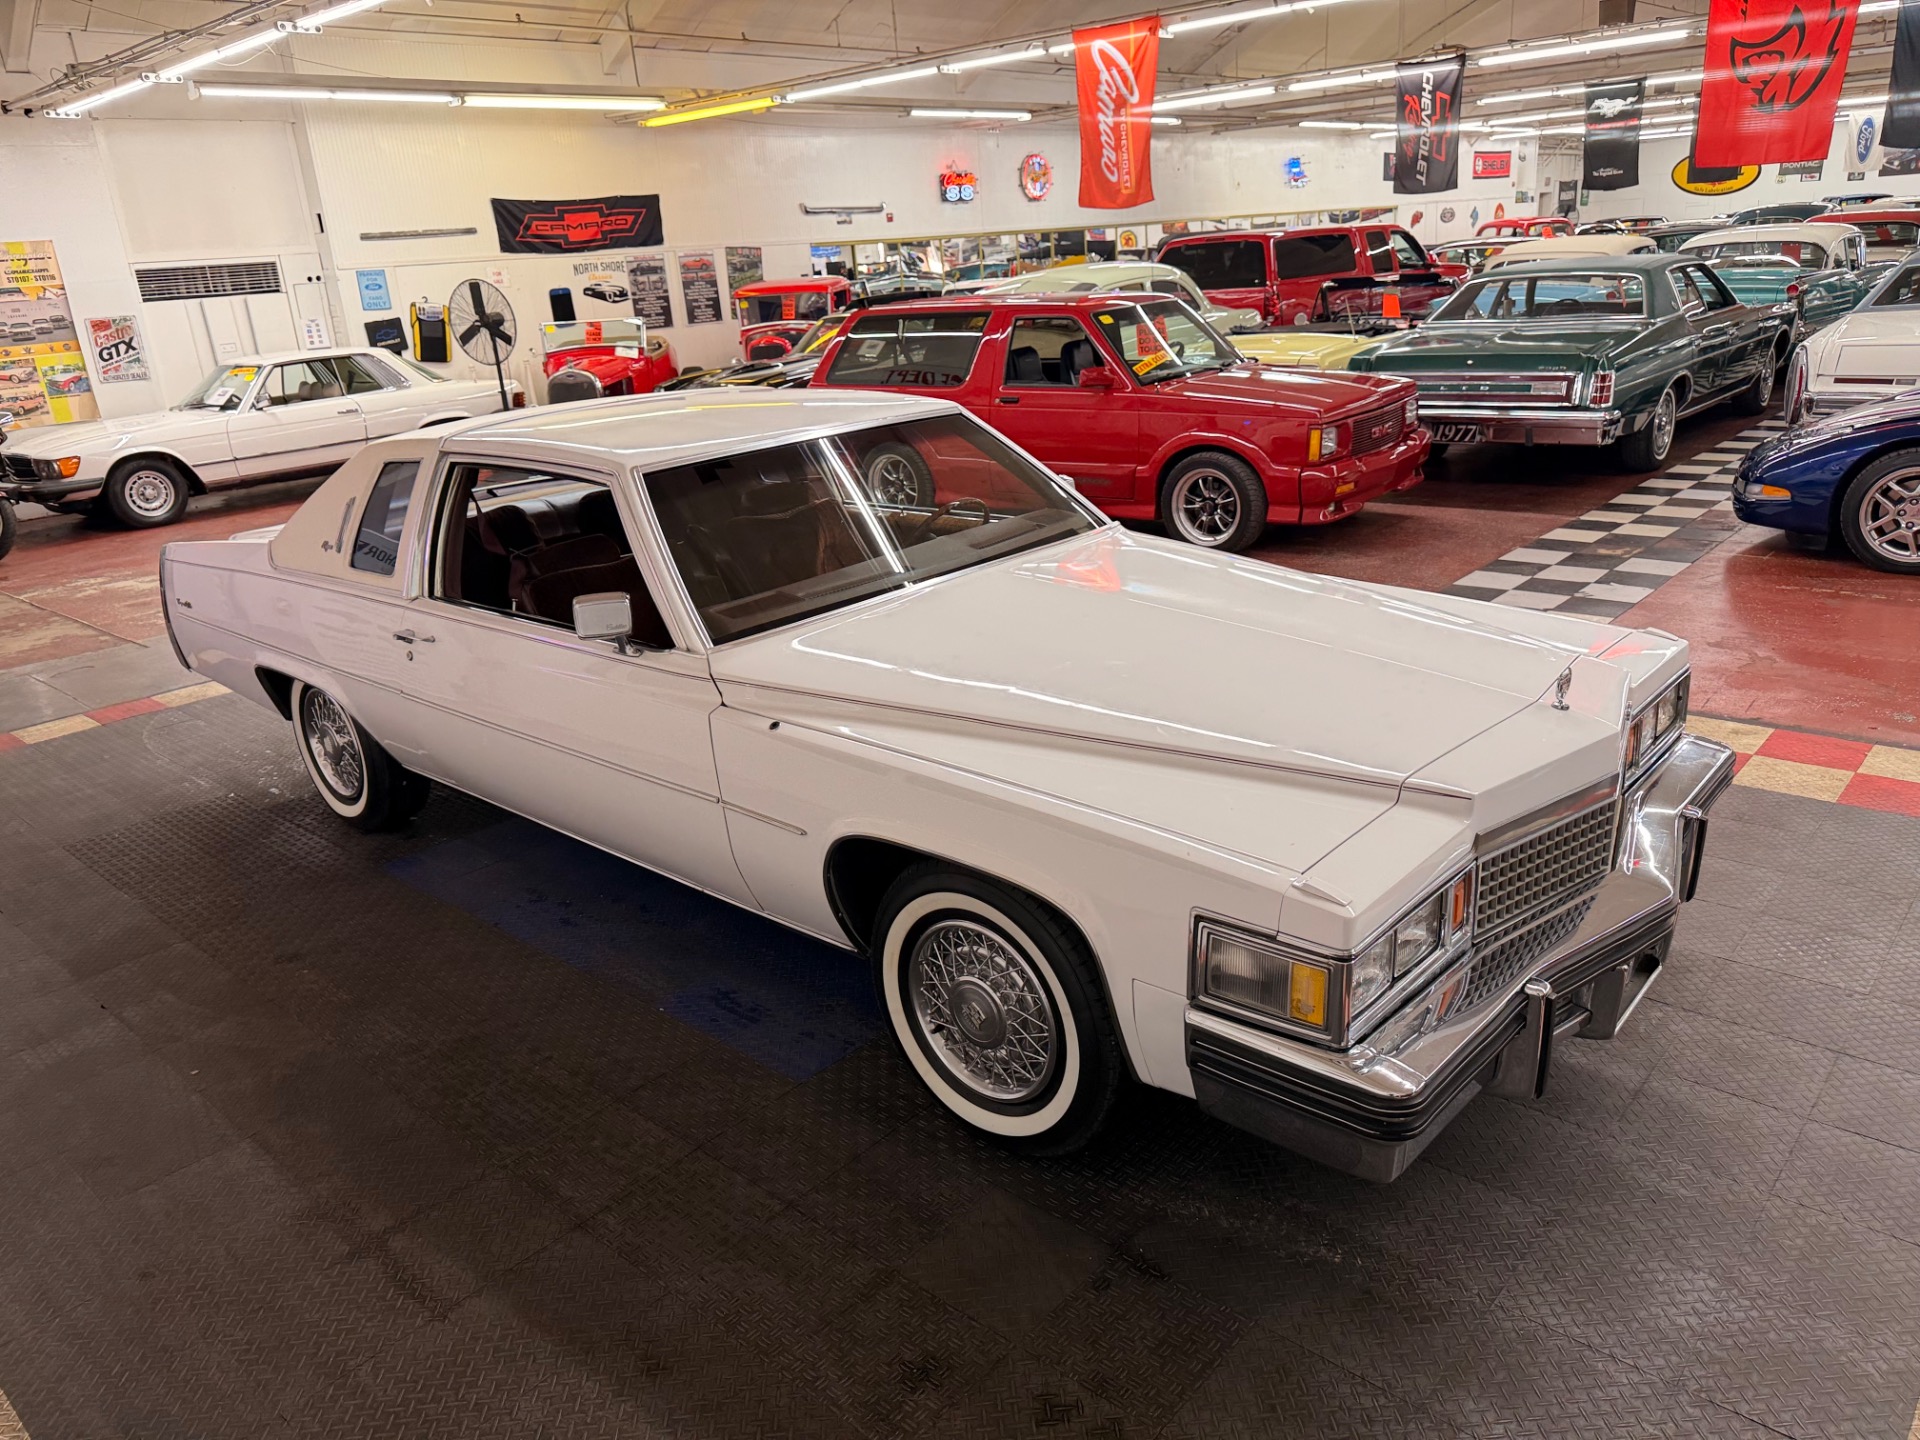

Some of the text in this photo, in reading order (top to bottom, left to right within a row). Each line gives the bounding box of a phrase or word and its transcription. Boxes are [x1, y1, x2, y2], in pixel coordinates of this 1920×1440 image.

[1091, 40, 1140, 183] Camaro
[1416, 71, 1433, 186] CHEVROLET
[1858, 124, 1873, 154] Ford
[1120, 124, 1132, 188] CHEVROLET
[1782, 160, 1820, 169] PONTIAC
[1482, 160, 1509, 170] SHELBY
[946, 185, 974, 201] SS
[535, 218, 628, 232] CAMARO
[573, 260, 626, 276] NORTH SHORE
[366, 300, 387, 308] ONLY
[98, 335, 138, 362] GTX
[1435, 424, 1477, 442] 1977
